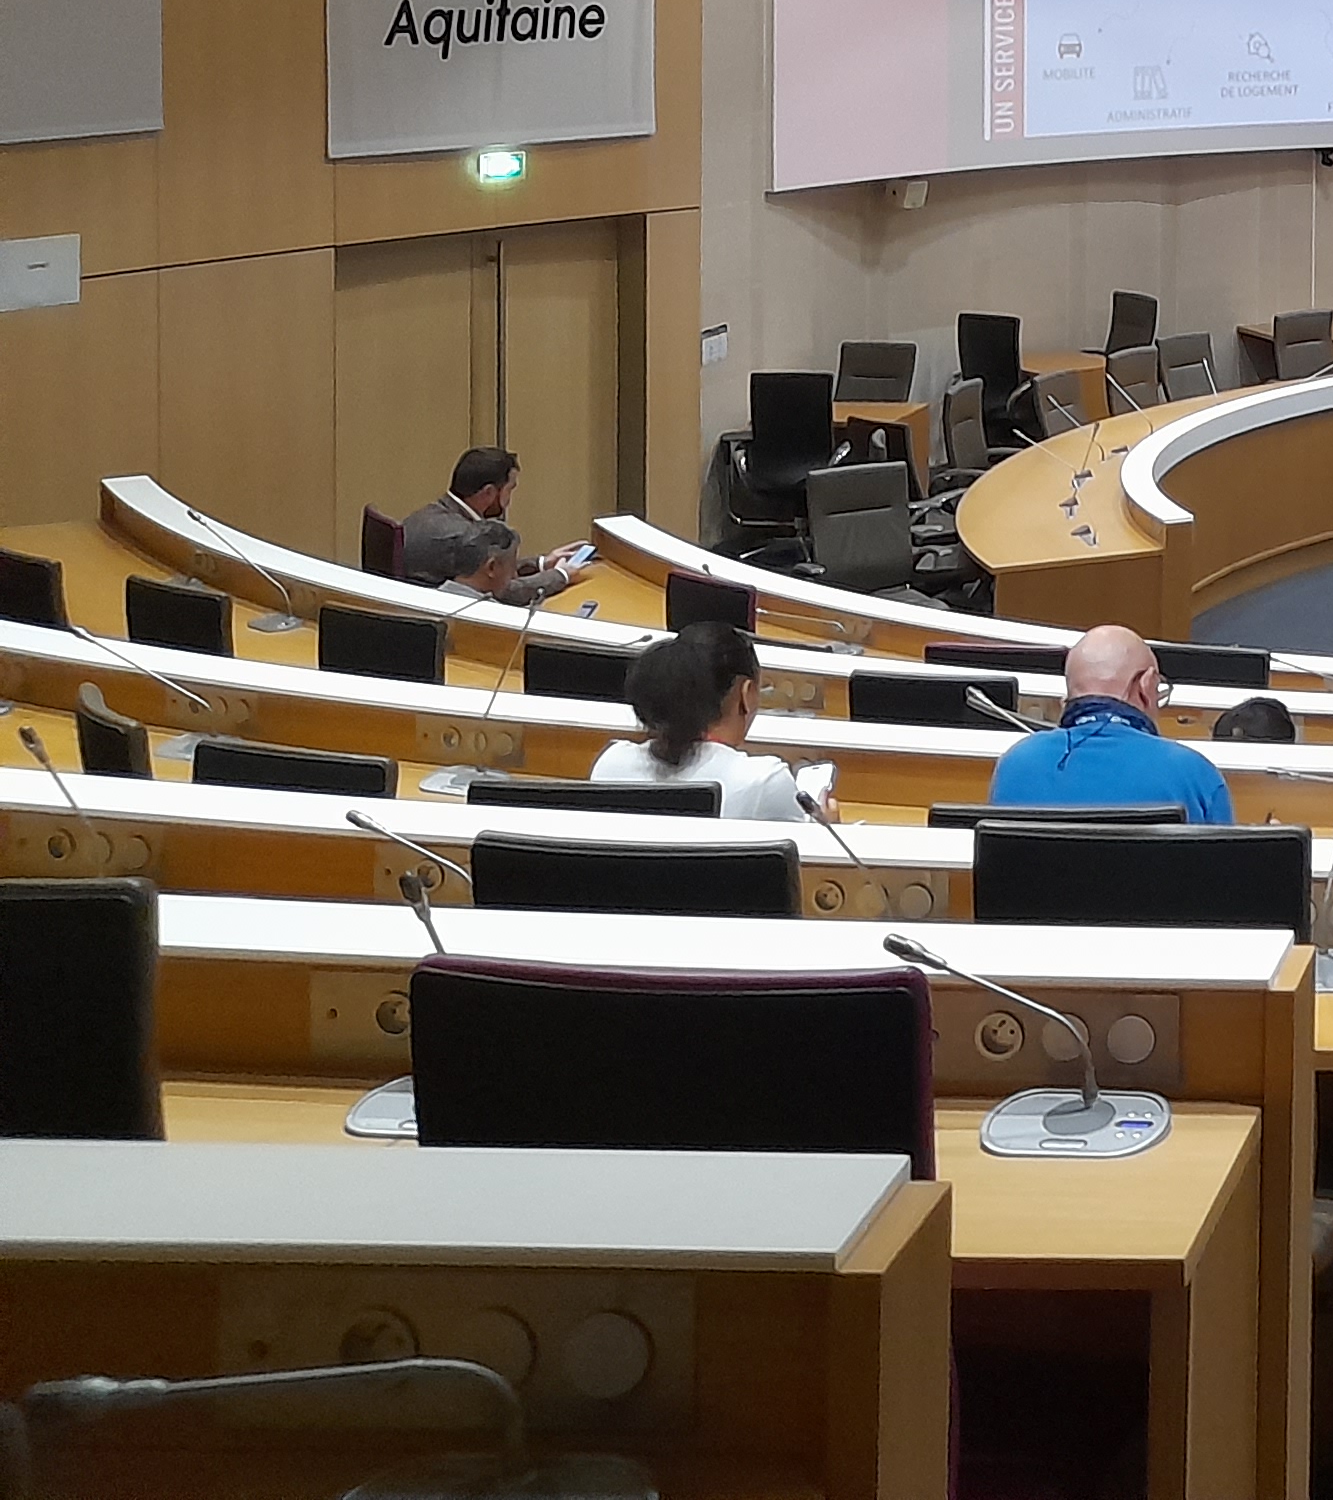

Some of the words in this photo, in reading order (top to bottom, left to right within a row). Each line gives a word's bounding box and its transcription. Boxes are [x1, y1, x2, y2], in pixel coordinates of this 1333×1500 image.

[1227, 70, 1292, 83] RECHERCHE
[1220, 86, 1236, 99] DE
[1237, 84, 1299, 98] LOGEMENT
[993, 102, 1016, 134] UN
[1106, 106, 1194, 124] ADMINISTRATIF
